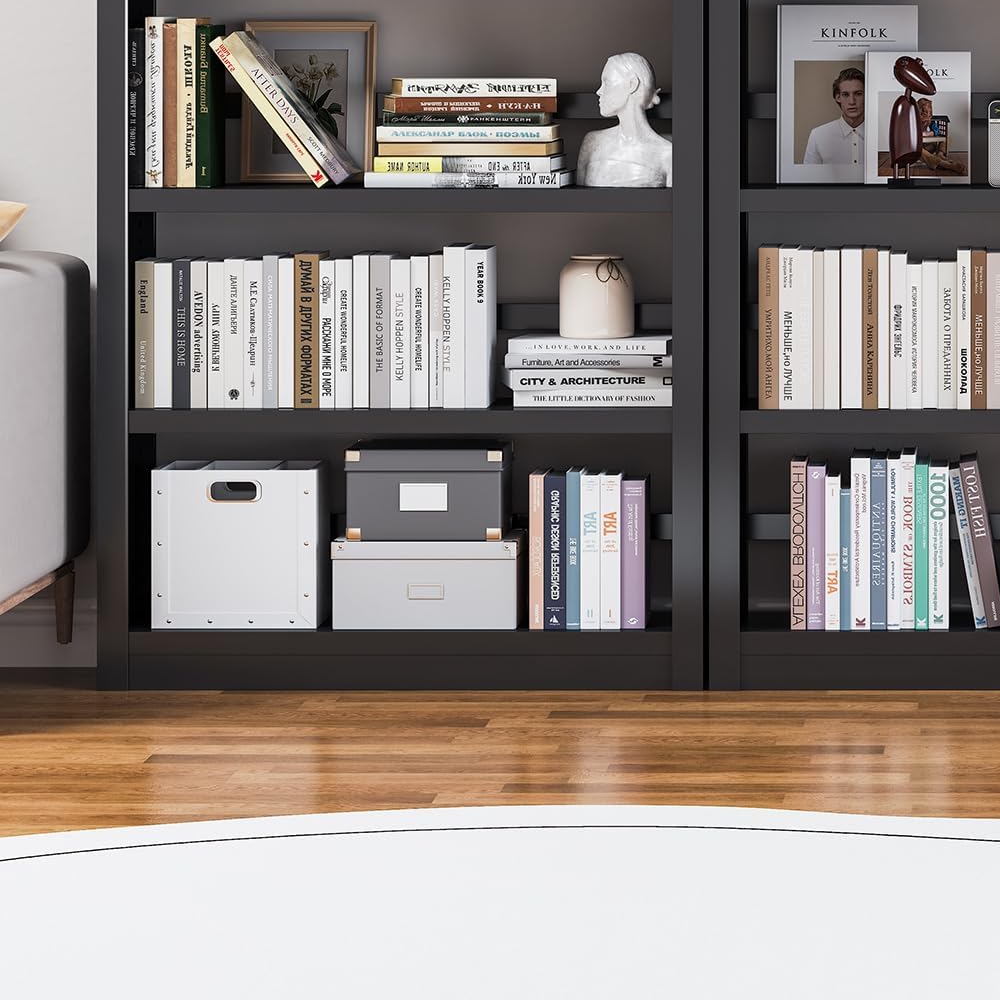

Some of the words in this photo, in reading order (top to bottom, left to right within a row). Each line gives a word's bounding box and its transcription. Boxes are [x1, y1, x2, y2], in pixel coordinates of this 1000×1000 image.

[821, 28, 889, 39] KINFOLK
[250, 67, 278, 99] AFTER
[275, 98, 298, 124] DAYS
[391, 130, 455, 138] АЛЕКСАНДР
[495, 130, 540, 138] ПОЭМЫ
[299, 259, 314, 294] ДУМАЙ
[476, 261, 484, 279] YEAR
[138, 279, 149, 314] England
[230, 274, 238, 298] ДАНТЕ
[442, 276, 451, 304] KELLY
[476, 279, 484, 298] BOOK
[176, 307, 186, 328] THIS
[193, 290, 203, 328] AVEDON
[230, 299, 238, 335] АЛИГЬЕРИ
[943, 287, 951, 321] ЗАБОТА
[176, 329, 186, 338] IS
[299, 305, 312, 342] ДРУГИХ
[321, 317, 332, 354] РАССКАЖИ
[442, 305, 451, 343] HOPPEN
[176, 340, 186, 367] HOME
[191, 329, 203, 373] advertising
[321, 355, 332, 370] МНЕ
[442, 344, 451, 372] STYLE
[521, 358, 554, 367] Furniture,
[554, 358, 565, 366] Art
[566, 358, 579, 366] and
[580, 358, 621, 367] Accessories
[943, 333, 951, 391] ПРЕДАННЫХ
[299, 344, 313, 396] ФОРМАТАХ
[519, 377, 546, 386] CITY
[548, 377, 557, 386] &
[560, 376, 646, 385] ARCHITECTURE
[959, 348, 968, 395] ШОКОЛАД
[321, 378, 332, 397] МОРЕ
